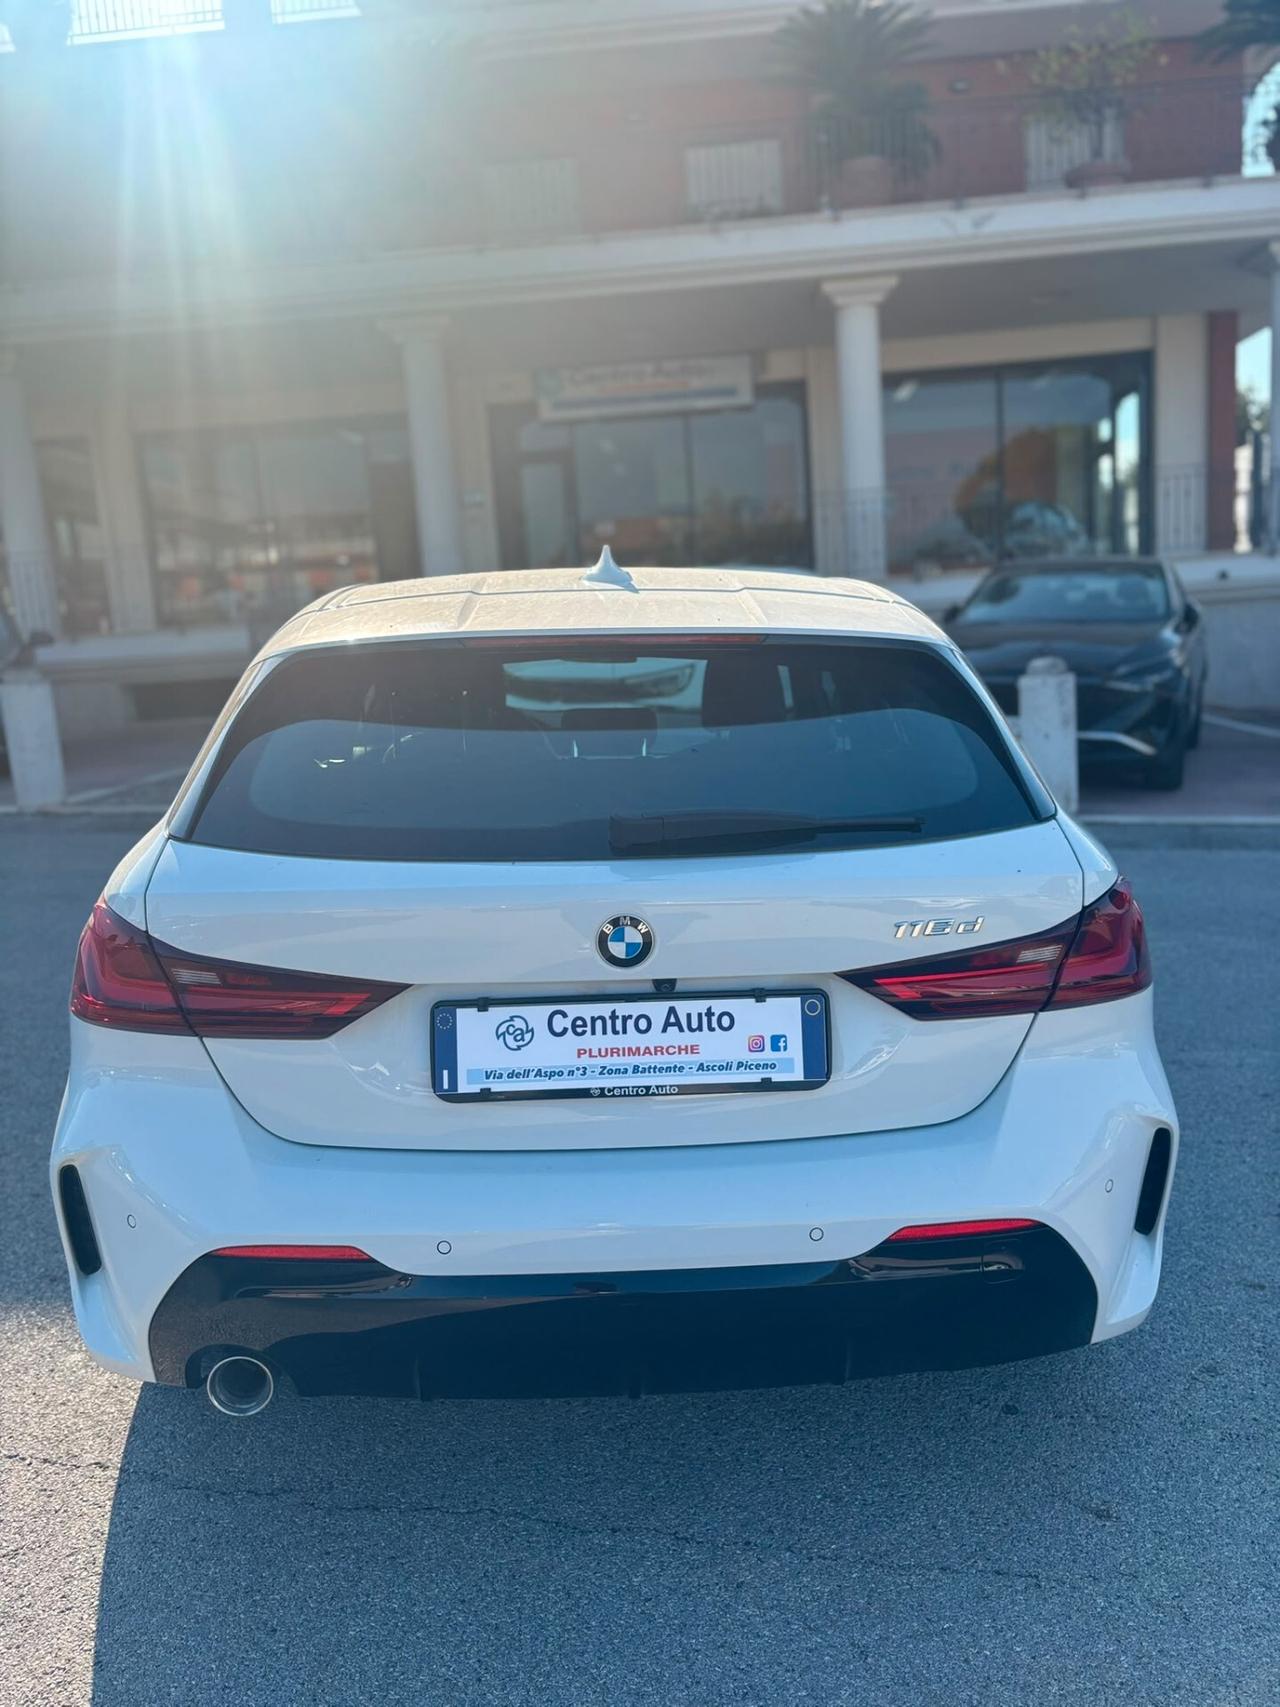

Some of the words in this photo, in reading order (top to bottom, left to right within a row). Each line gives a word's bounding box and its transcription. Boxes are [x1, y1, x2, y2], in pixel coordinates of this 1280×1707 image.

[602, 916, 649, 935] BMW
[894, 915, 985, 938] 116d
[547, 1008, 653, 1037] Centro
[661, 1005, 735, 1034] Auto
[577, 1044, 700, 1058] PLURIMARCHE
[484, 1069, 504, 1080] Via
[599, 1064, 629, 1076] Zona
[631, 1062, 686, 1076] Battente
[695, 1060, 733, 1073] Ascoli
[735, 1058, 777, 1072] Piceno
[604, 1086, 647, 1096] Centro
[649, 1084, 679, 1095] Auto
